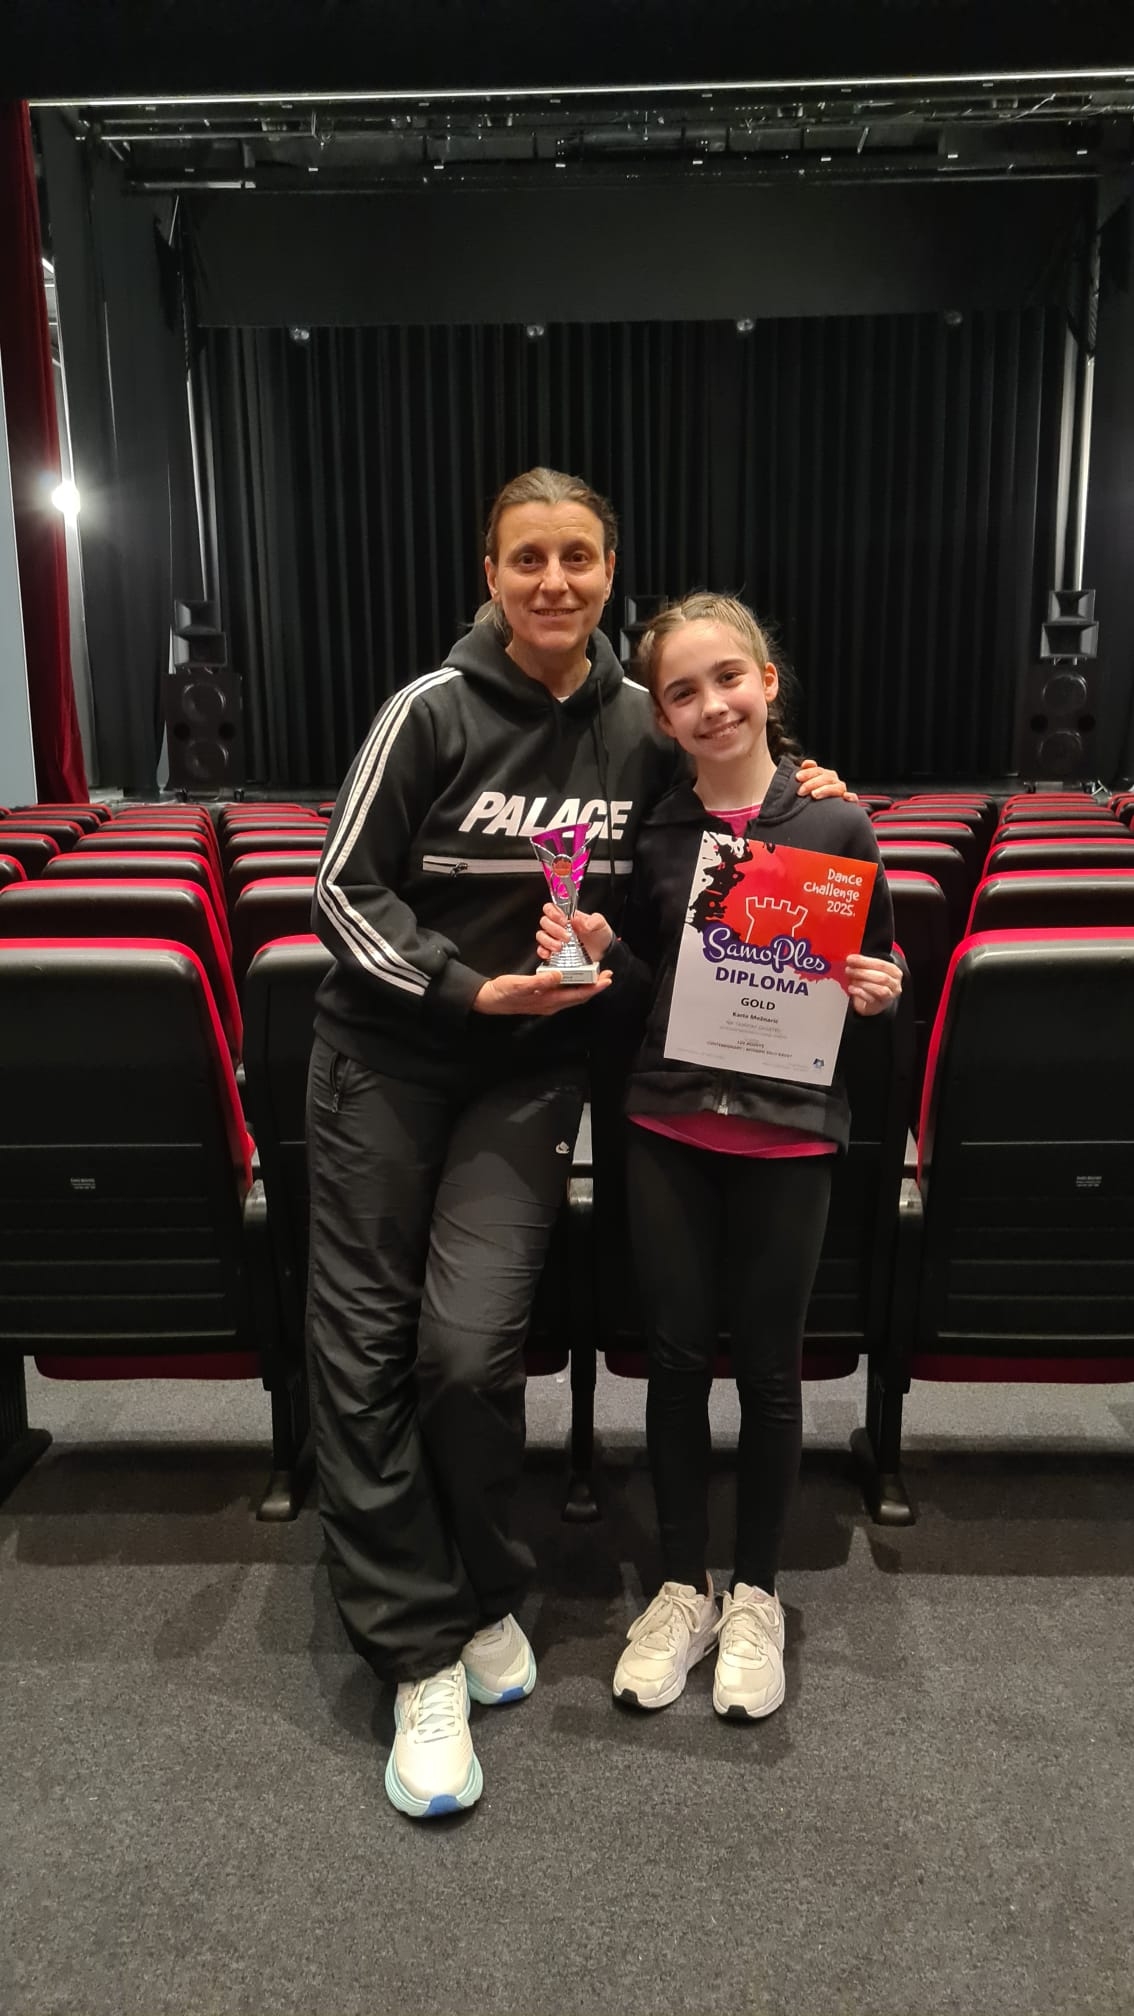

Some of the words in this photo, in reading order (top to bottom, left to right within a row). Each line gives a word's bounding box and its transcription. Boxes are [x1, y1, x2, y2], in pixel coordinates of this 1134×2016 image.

[458, 791, 633, 840] PALACE
[828, 868, 863, 887] Dance
[803, 882, 860, 902] Challenge
[826, 900, 856, 917] 2025.
[708, 927, 826, 972] SamoPles
[715, 967, 809, 996] DIPLOMA
[740, 997, 776, 1011] GOLD
